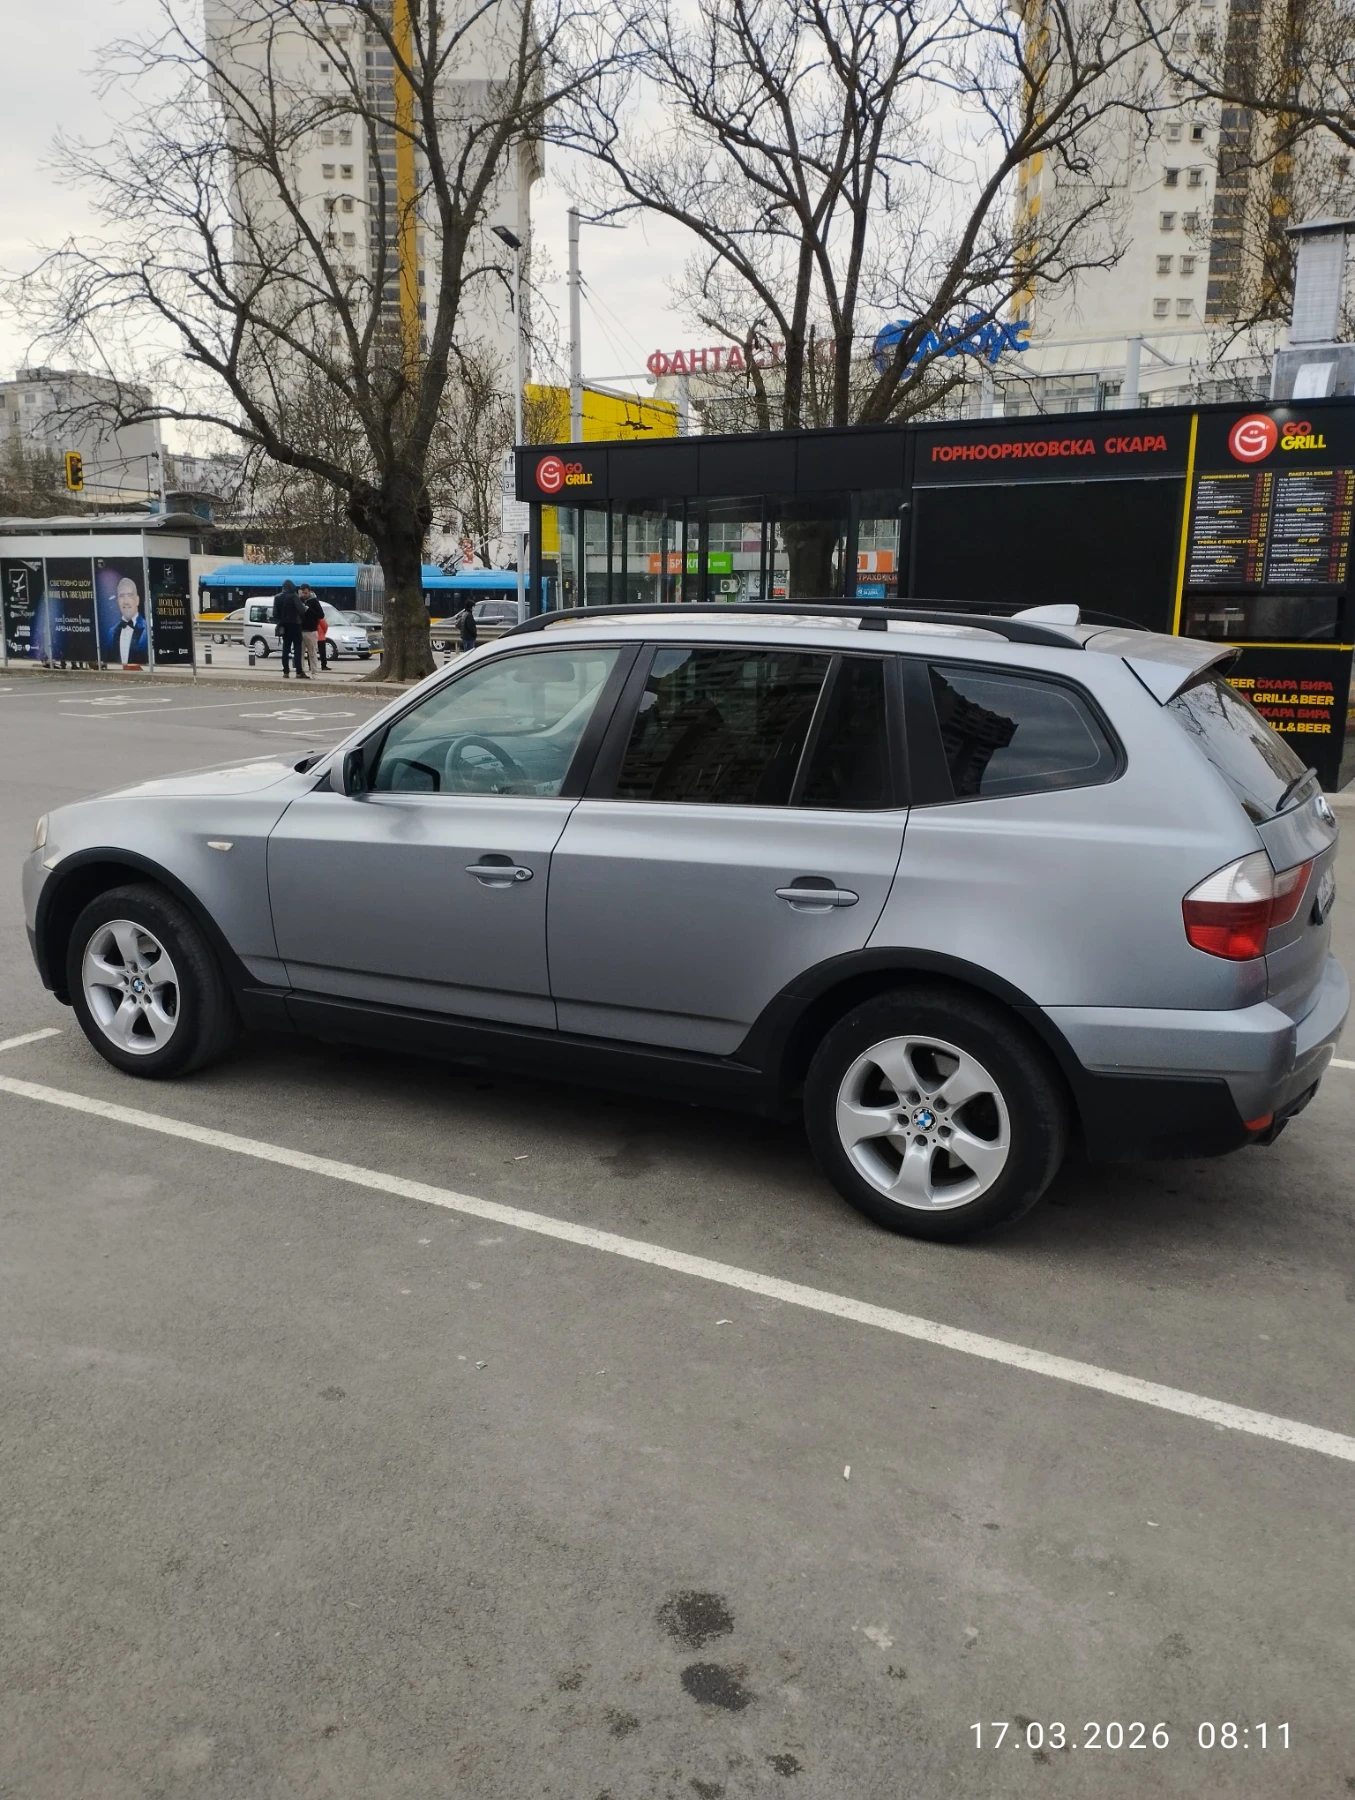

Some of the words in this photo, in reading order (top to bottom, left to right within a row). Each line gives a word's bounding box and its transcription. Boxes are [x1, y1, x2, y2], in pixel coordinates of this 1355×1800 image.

[1282, 421, 1312, 436] GO
[931, 439, 1096, 462] ГОРНООРЯХОВСКА
[1104, 435, 1168, 454] СКАРА
[1281, 435, 1326, 450] GRILL
[565, 462, 583, 474] GO
[565, 473, 592, 485] GRILL
[1257, 679, 1298, 690] СКАРА
[1300, 680, 1334, 691] БИРА
[1253, 693, 1334, 705] GRILL&BEER
[1297, 708, 1330, 719] БИРА
[1269, 722, 1331, 733] ILL&BEER
